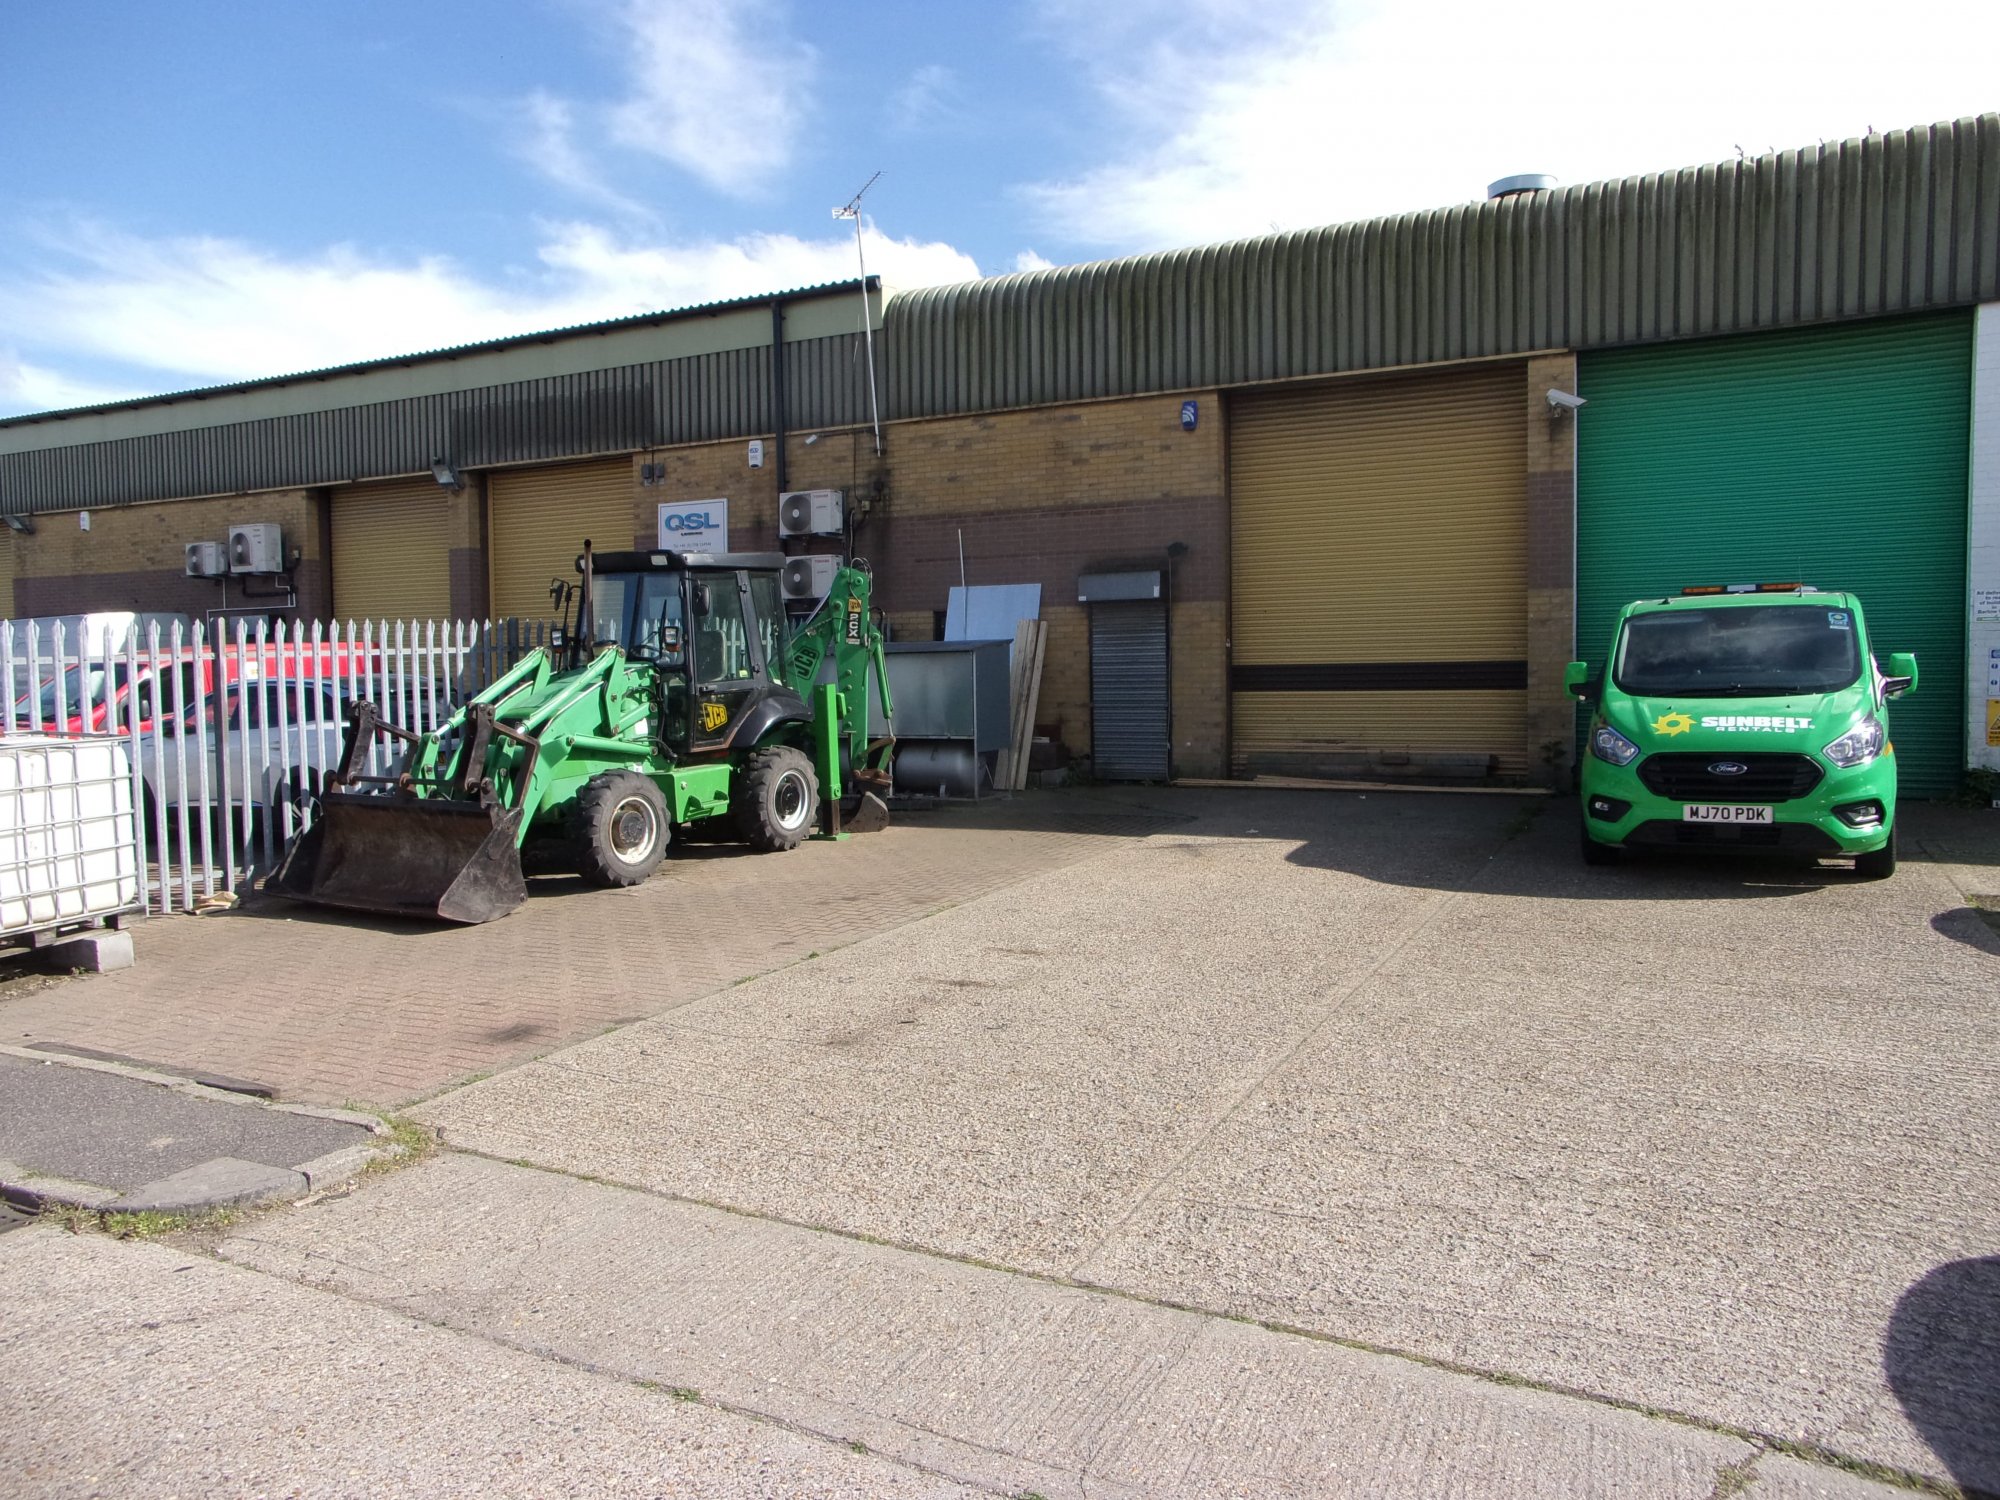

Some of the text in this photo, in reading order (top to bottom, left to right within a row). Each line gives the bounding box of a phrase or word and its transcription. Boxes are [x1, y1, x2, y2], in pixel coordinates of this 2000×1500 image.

[664, 512, 720, 531] QSL
[795, 649, 817, 677] JCB
[706, 705, 726, 728] JCB
[1701, 716, 1813, 729] SUNBELT
[1690, 807, 1766, 820] MJ70 PDK
